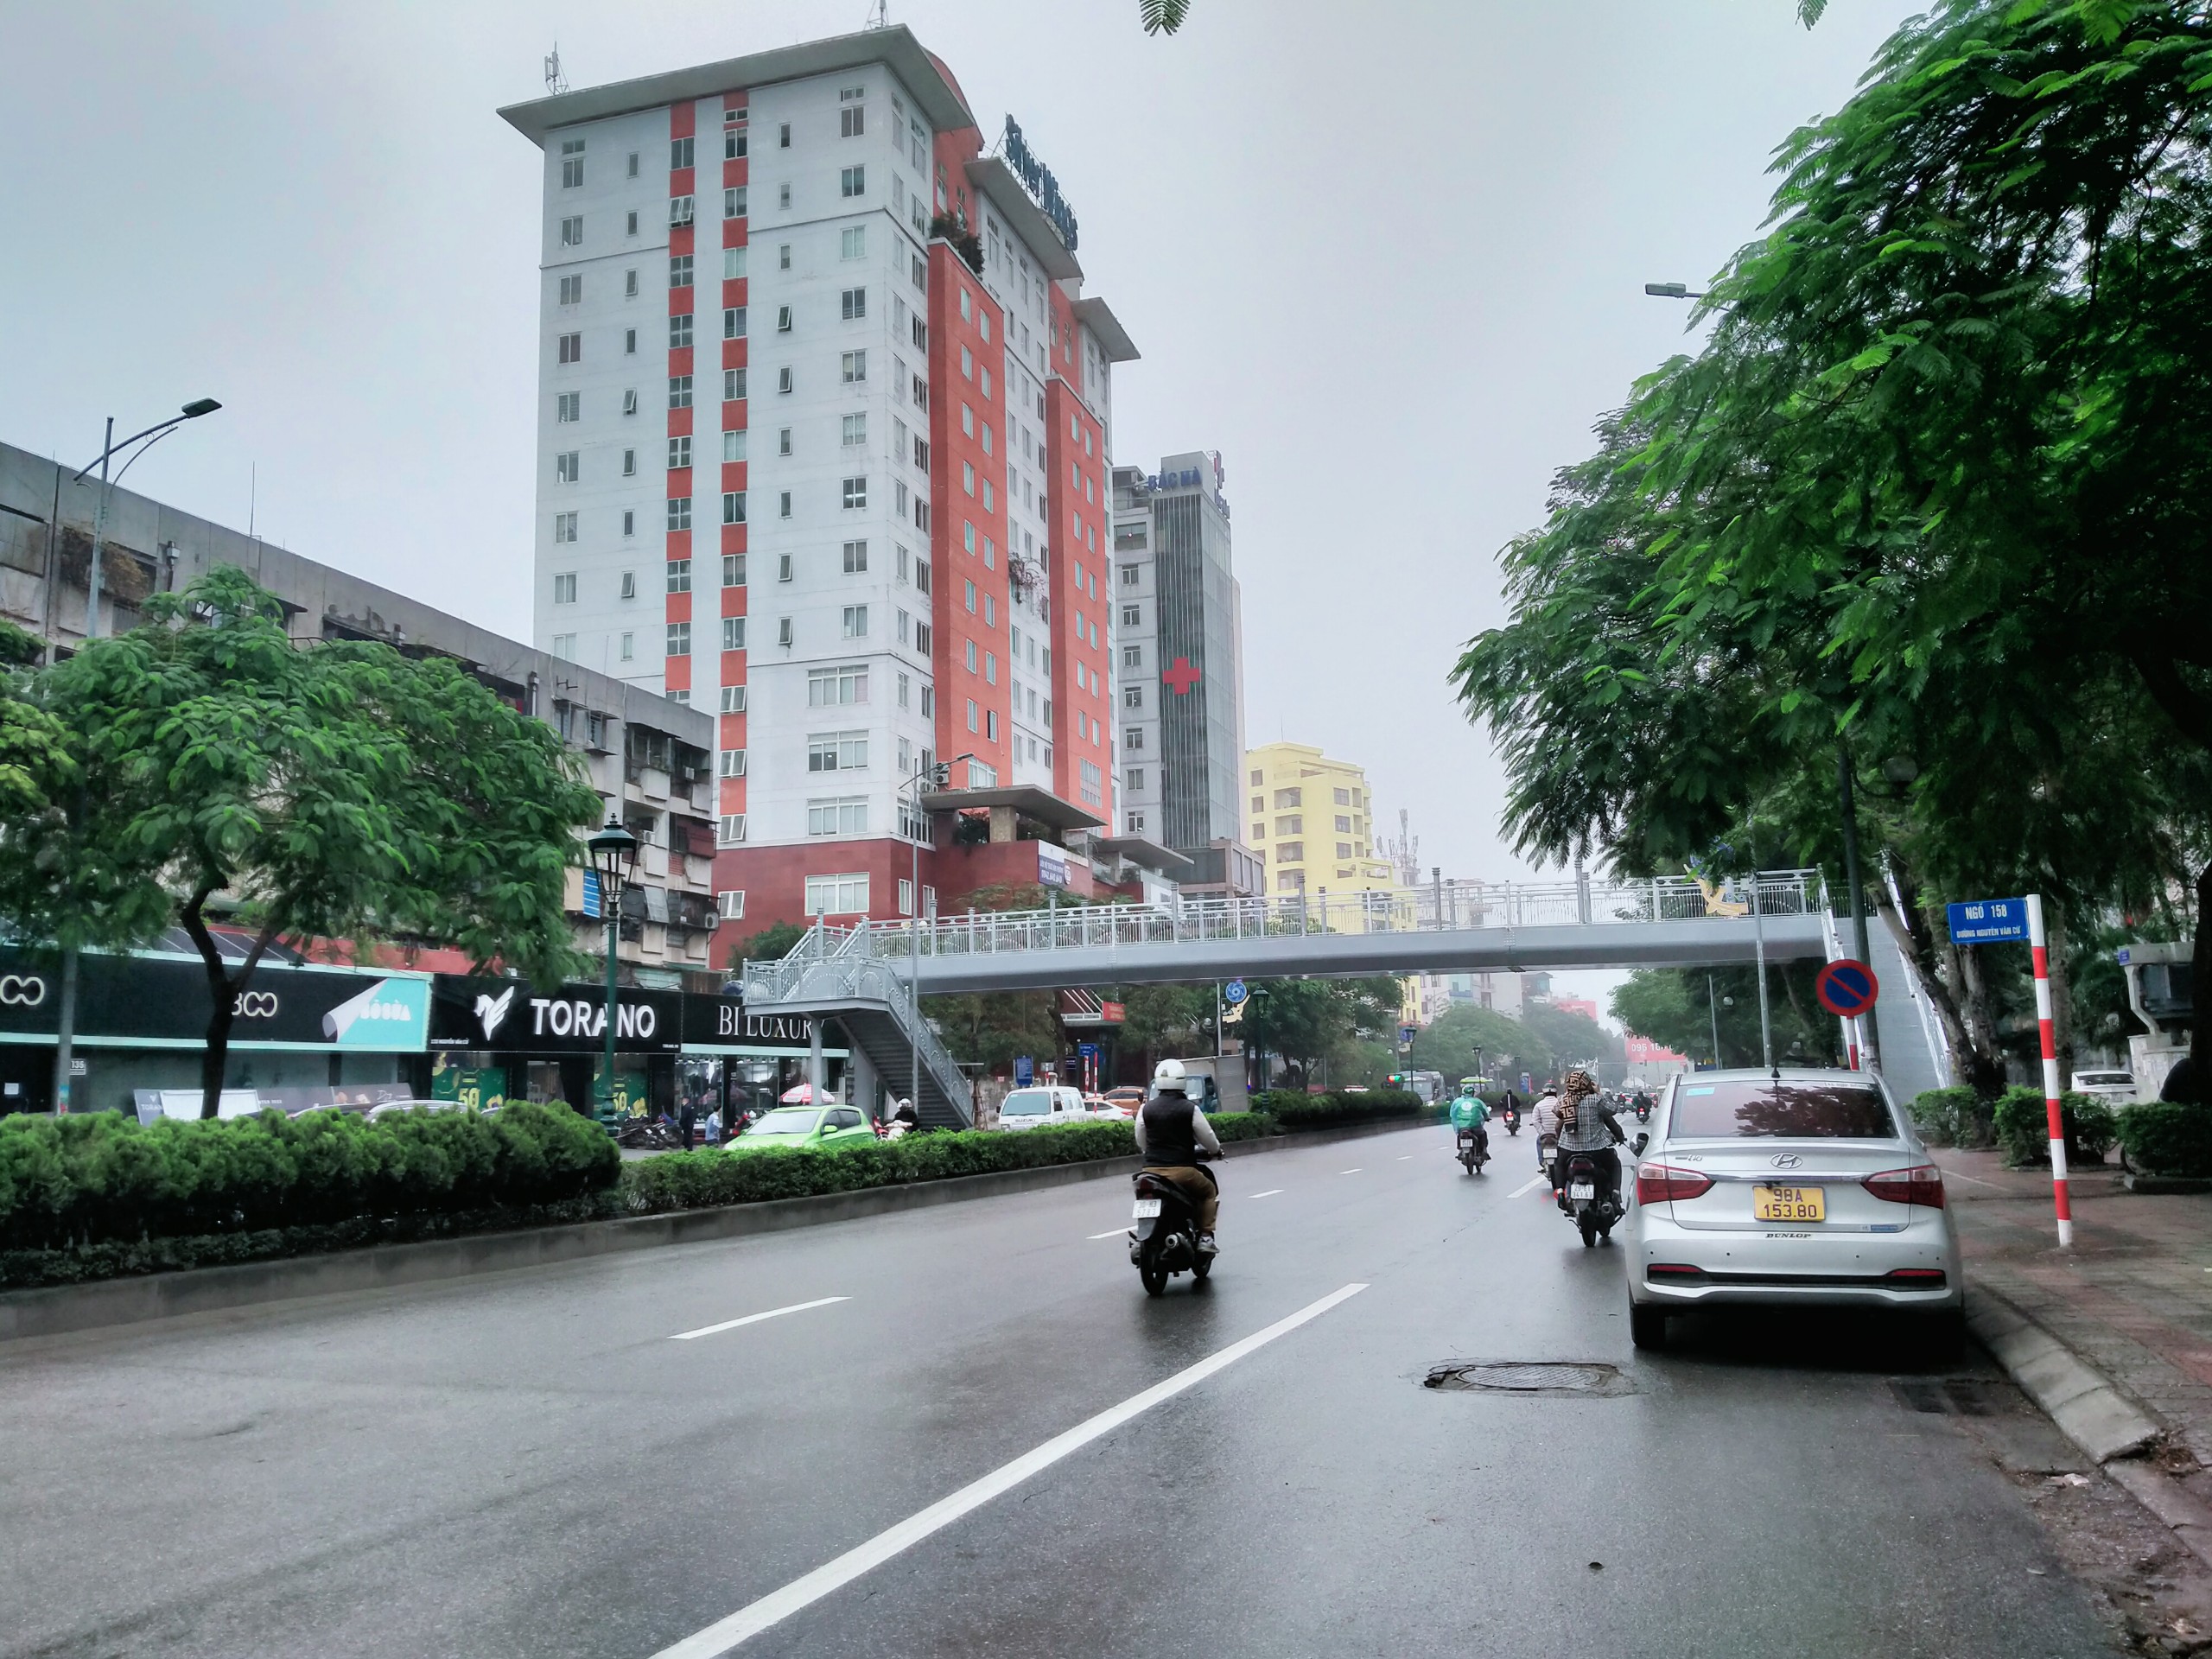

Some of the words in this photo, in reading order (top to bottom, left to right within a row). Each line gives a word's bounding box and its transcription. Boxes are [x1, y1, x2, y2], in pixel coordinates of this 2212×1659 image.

[1965, 903, 1985, 920] NGÕ
[1991, 904, 2007, 918] 158
[530, 998, 656, 1038] TORANO
[718, 1005, 740, 1036] BI
[747, 1015, 825, 1039] LUXUR
[1631, 1043, 1648, 1052] 096
[71, 1060, 85, 1069] 135
[1773, 1188, 1803, 1203] 98A
[1764, 1204, 1818, 1218] 153.80
